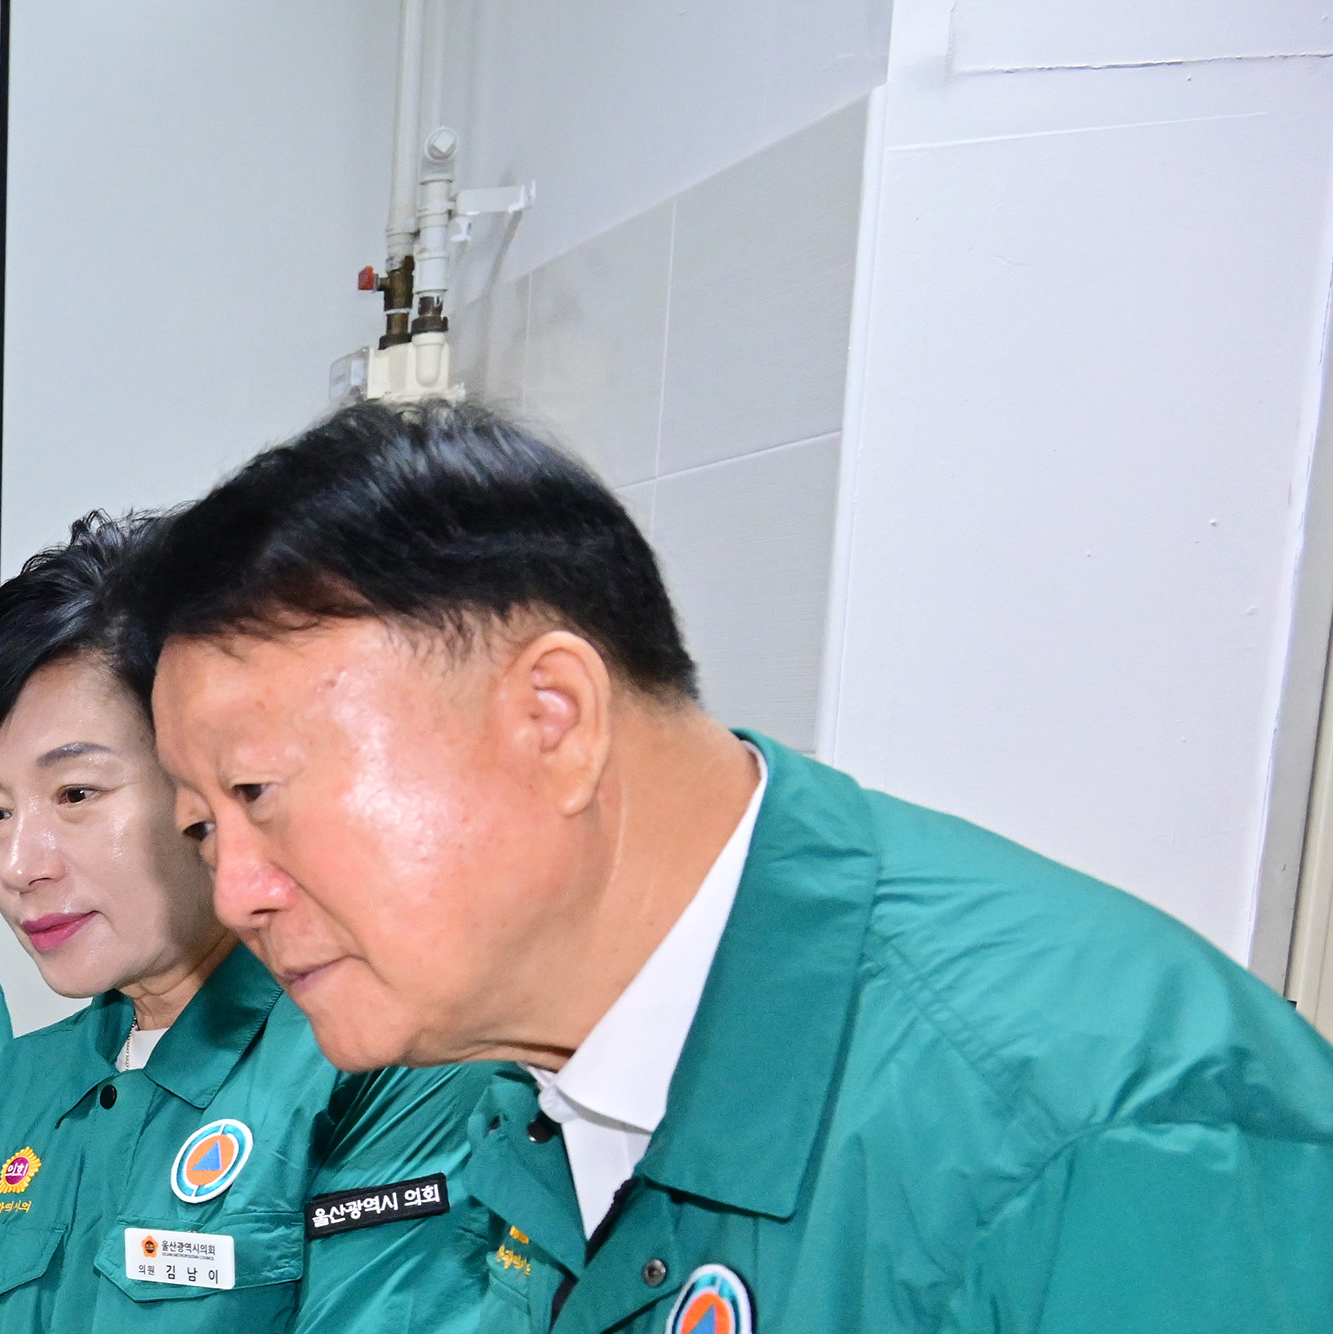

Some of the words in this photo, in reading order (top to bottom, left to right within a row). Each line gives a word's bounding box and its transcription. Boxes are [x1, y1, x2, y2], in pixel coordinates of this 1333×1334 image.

[312, 1192, 399, 1228] 울산광역시
[404, 1184, 440, 1206] 의회
[161, 1240, 216, 1255] 울산광역시의회
[138, 1264, 155, 1275] 의원
